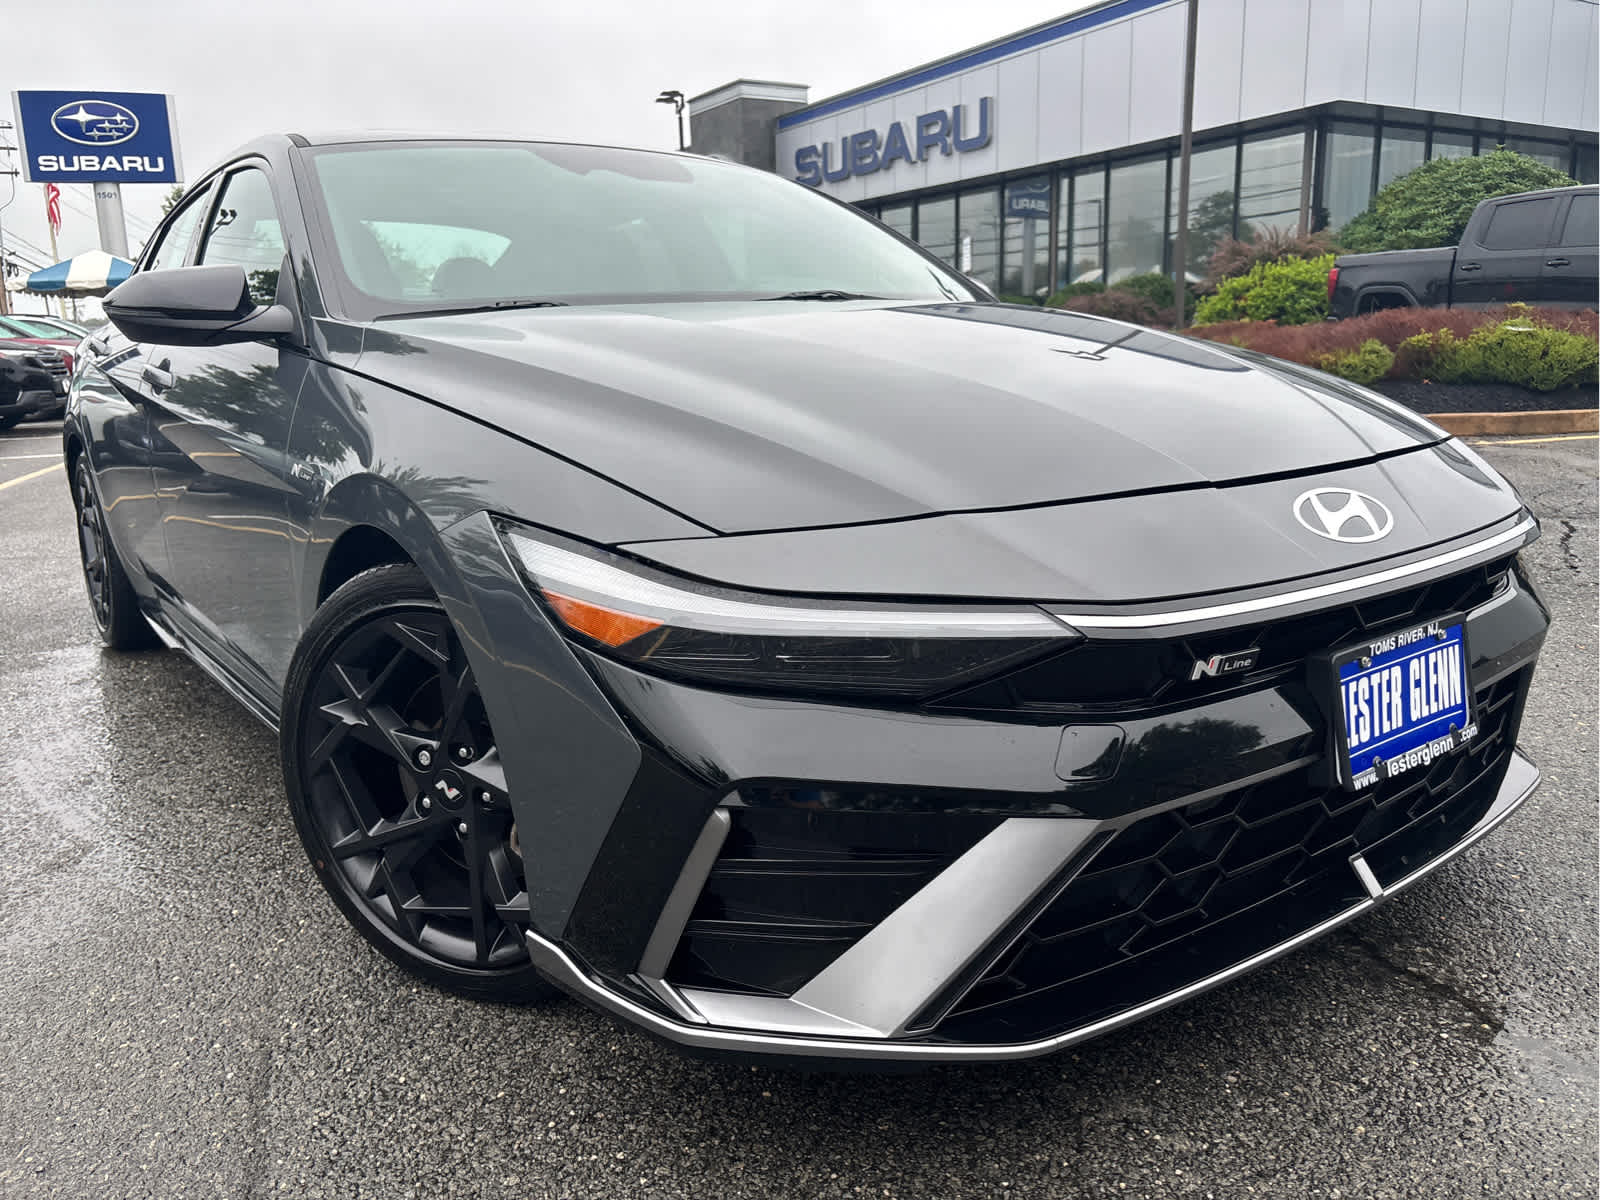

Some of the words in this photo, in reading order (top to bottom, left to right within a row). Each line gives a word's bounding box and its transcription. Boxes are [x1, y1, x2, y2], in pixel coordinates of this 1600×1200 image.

[795, 97, 992, 187] SUBARU
[38, 155, 165, 172] SUBARU
[97, 191, 118, 199] 1501
[1369, 636, 1396, 657] TOMS
[1223, 659, 1252, 671] Line
[1409, 644, 1462, 722] GLENN
